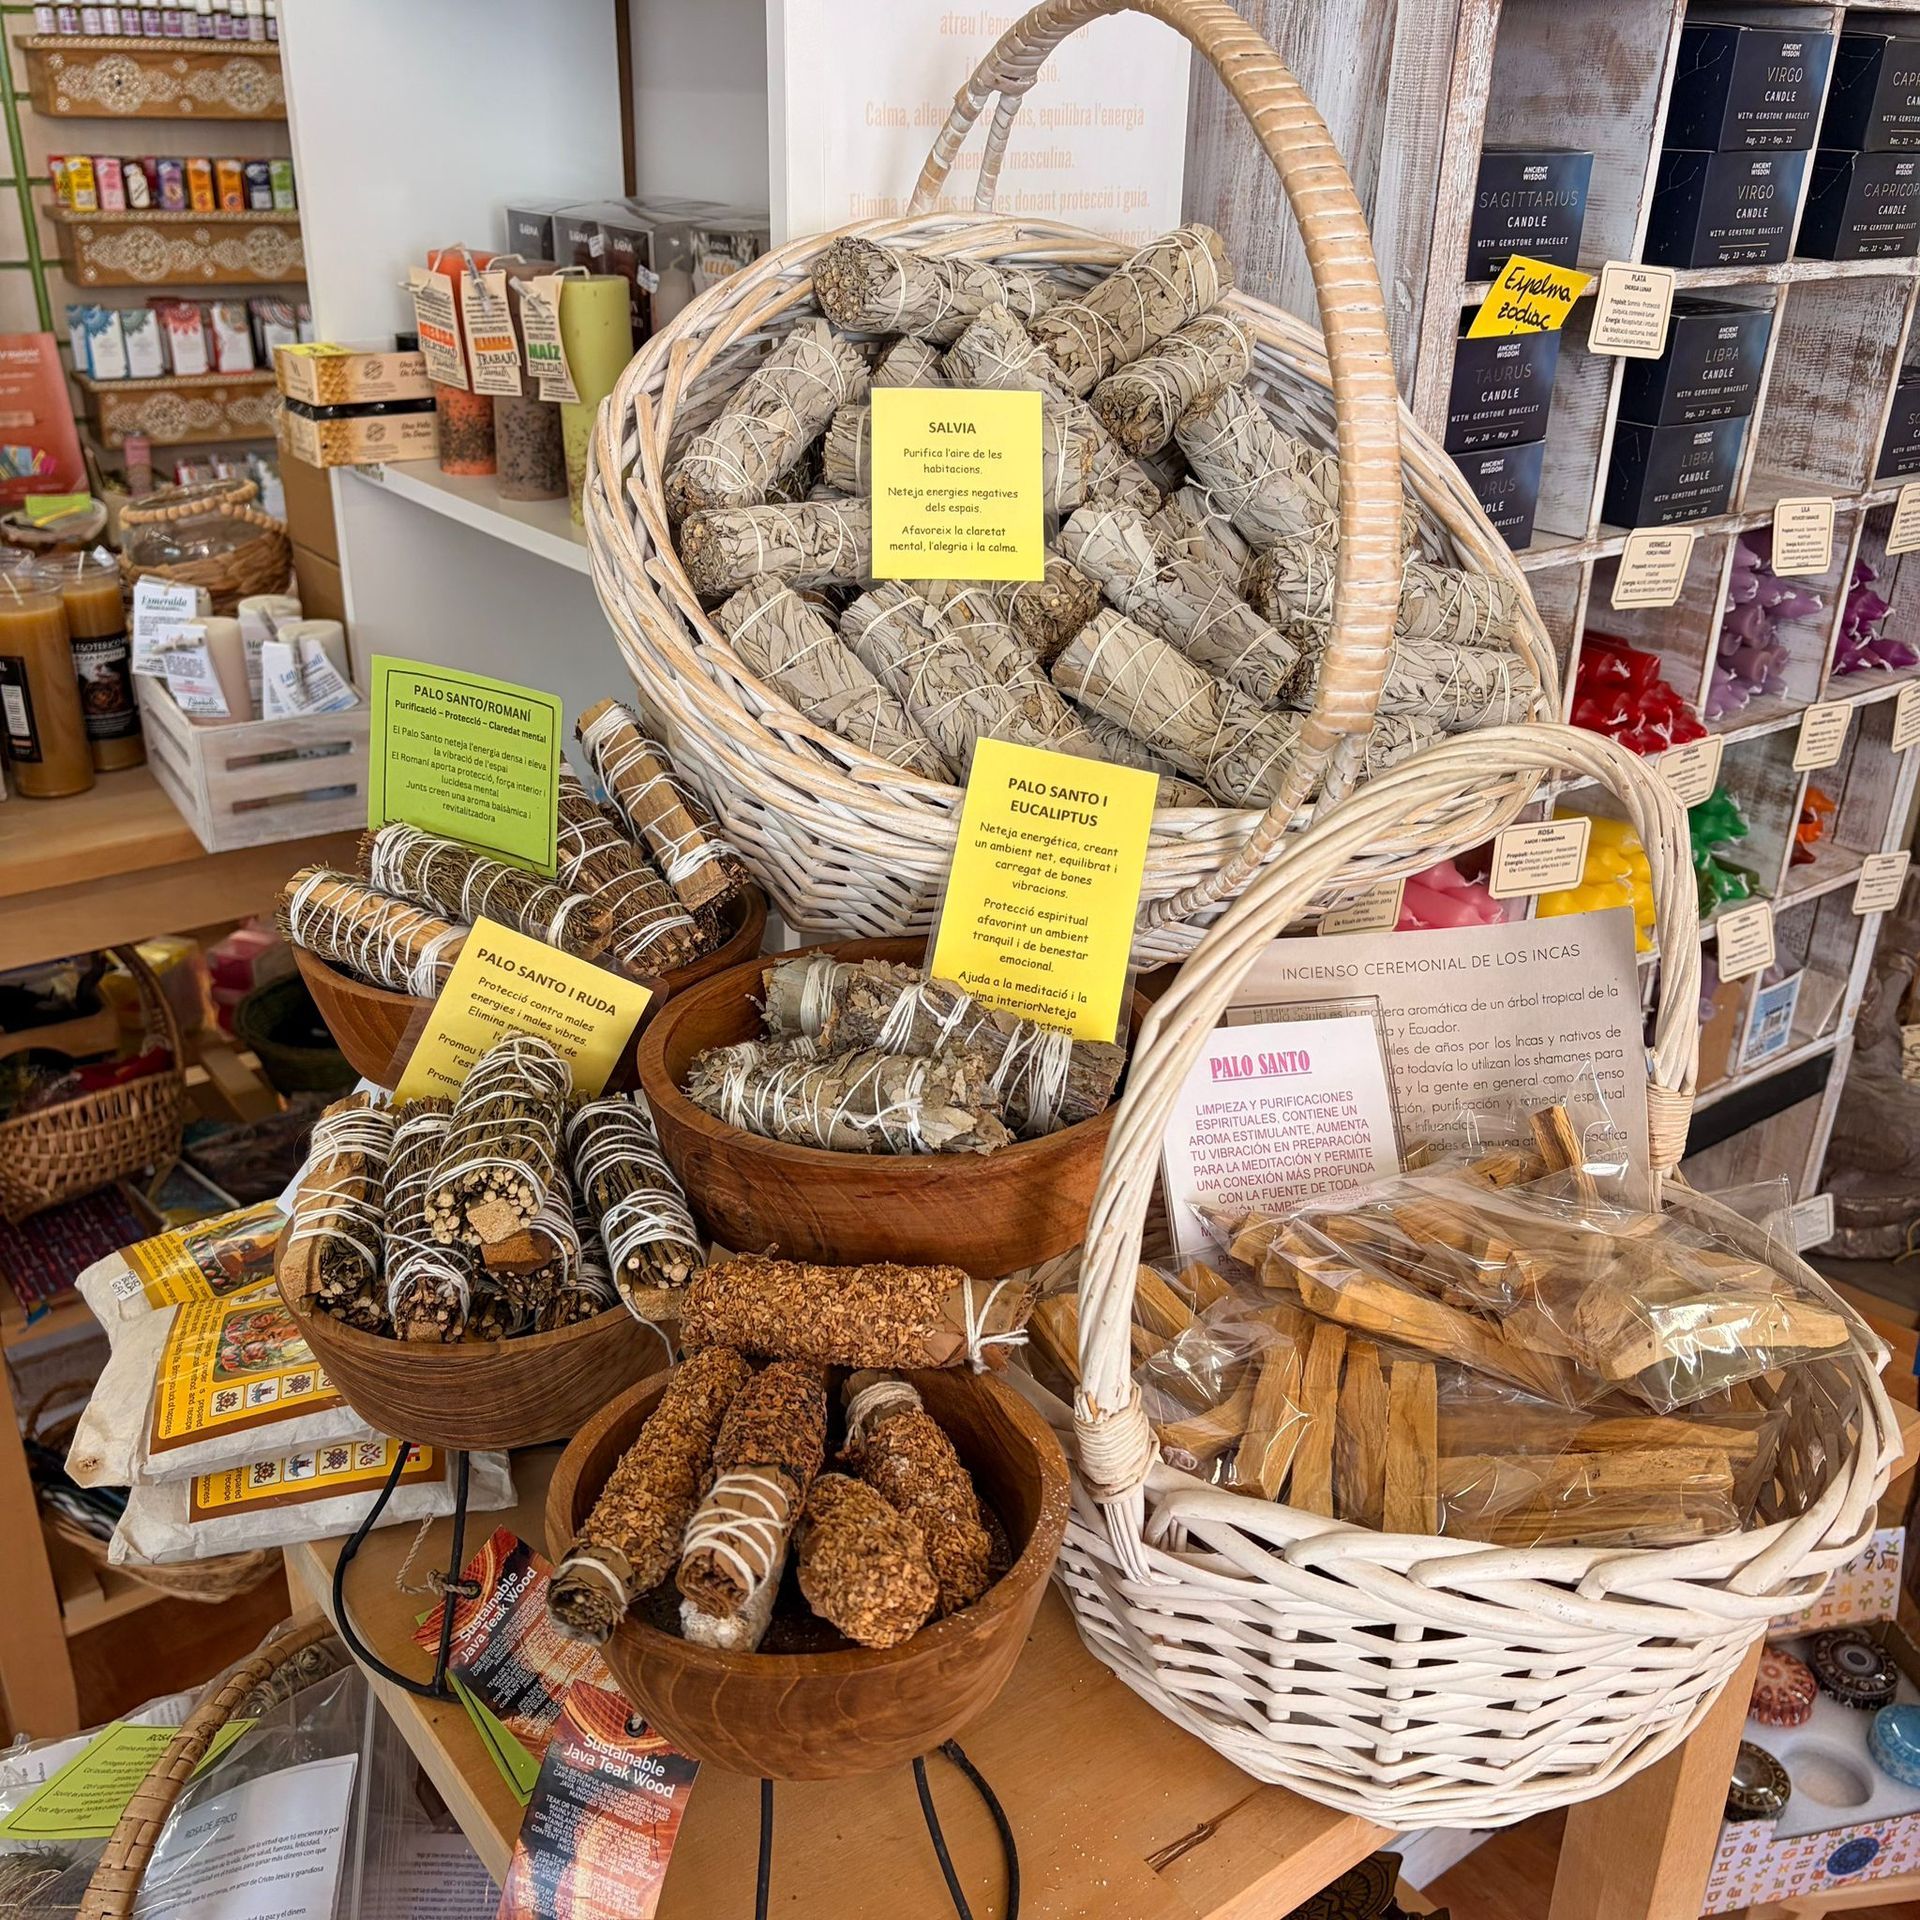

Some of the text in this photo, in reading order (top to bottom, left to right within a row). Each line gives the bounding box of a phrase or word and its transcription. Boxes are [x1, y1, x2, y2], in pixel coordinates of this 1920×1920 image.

[1767, 66, 1803, 82] VIRGO
[1764, 90, 1796, 101] CANDLE
[865, 103, 1144, 132] Calma, equilibra l'energia
[1009, 145, 1074, 170] masculina.
[1015, 188, 1056, 212] donant
[1059, 186, 1113, 216] protecció
[1122, 185, 1150, 213] guia.
[1479, 190, 1578, 208] SAGITTARIUS
[1738, 184, 1774, 200] VIRGO
[1736, 207, 1768, 219] CANDLE
[1878, 204, 1906, 214] CANDLE
[1507, 215, 1547, 227] CANDLE
[1477, 236, 1568, 247] WITH GEMSTONE BRACELET
[476, 351, 517, 366] TRABAJO
[528, 342, 561, 360] MAÍZ
[1705, 347, 1738, 363] LIBRA
[1476, 363, 1533, 384] TAURUS
[1702, 367, 1734, 380] CANDLE
[1481, 387, 1519, 402] CANDLE
[929, 421, 976, 434] SALVIA
[903, 447, 1002, 459] Purifica l'aire de les
[1681, 450, 1714, 467] LIBRA
[923, 463, 981, 474] habitacions.
[1679, 470, 1710, 484] CANDLE
[888, 487, 1018, 500] Neteja energies negatives
[925, 502, 981, 515] dels espais.
[901, 524, 1005, 536] Afavoreix la claretat
[889, 540, 926, 552] mental,
[929, 540, 967, 553] l'alegria
[976, 541, 985, 551] la
[988, 542, 1017, 552] calma.
[141, 596, 187, 607] Esmeralda
[414, 684, 531, 722] PALO SANTO/ROMANÍ
[395, 699, 546, 743] Purificació Protecció Claredat mental
[392, 724, 400, 734] El
[401, 726, 419, 738] Palo
[420, 731, 443, 743] Santo
[444, 737, 467, 750] neteja
[469, 742, 500, 758] l'energia
[501, 751, 523, 764] densa
[527, 759, 546, 771] eleva
[1008, 777, 1046, 795] PALO
[1049, 785, 1099, 805] SANTO
[1010, 800, 1097, 826] EUCALIPTUS
[979, 821, 1118, 856] Neteja energética, creant
[974, 840, 987, 848] un
[989, 843, 1032, 856] ambient
[1035, 852, 1056, 863] net,
[1059, 856, 1111, 872] equilibrat
[995, 861, 1092, 885] carregat de bones
[1012, 880, 1067, 898] vibracions.
[983, 897, 1088, 926] Protecció espiritual
[977, 914, 1088, 943] afavorint un ambient
[973, 930, 1014, 947] tranquil
[1022, 940, 1036, 951] de
[1039, 942, 1088, 960] benestar
[999, 955, 1053, 972] emocional.
[1282, 943, 1580, 980] INCIENSO CEREMONIAL DE LOS INCAS
[477, 948, 615, 1016] PALO SANTO I RUDA
[478, 976, 594, 1032] Protecció contra males
[1407, 984, 1618, 1016] aromática de un árbol tropical de la
[468, 1005, 505, 1027] Elimina
[470, 992, 587, 1046] energies i males vibres.
[1397, 1020, 1460, 1038] y Ecuador.
[1209, 1050, 1311, 1079] PALO SANTO
[1195, 1090, 1353, 1116] LIMPIEZA Y PURIFICACIONES
[1195, 1104, 1357, 1131] ESPIRITUALES, CONTIENE UN
[1188, 1118, 1369, 1146] AROMA ESTIMULANTE, AUMENTA
[460, 1572, 518, 1642] Sustainable
[461, 1566, 537, 1663] Java Teak Wood
[583, 1734, 665, 1777] Sustainable
[563, 1744, 675, 1798] Java Teak Wood
